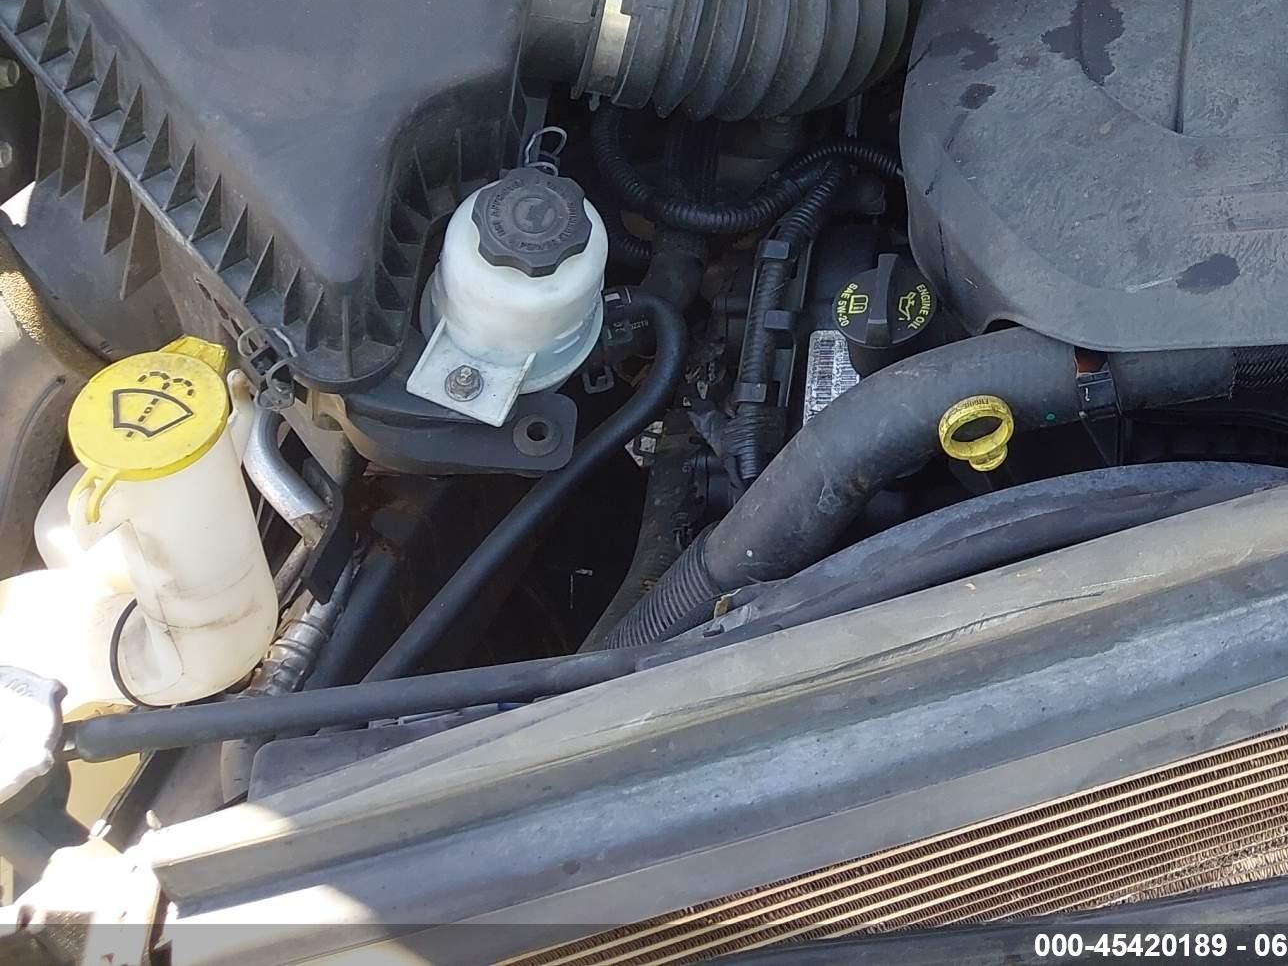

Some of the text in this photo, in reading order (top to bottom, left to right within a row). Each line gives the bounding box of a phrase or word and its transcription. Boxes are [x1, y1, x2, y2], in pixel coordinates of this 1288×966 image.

[836, 282, 858, 327] SAE 5W-20
[907, 284, 931, 330] ENGINE OIL
